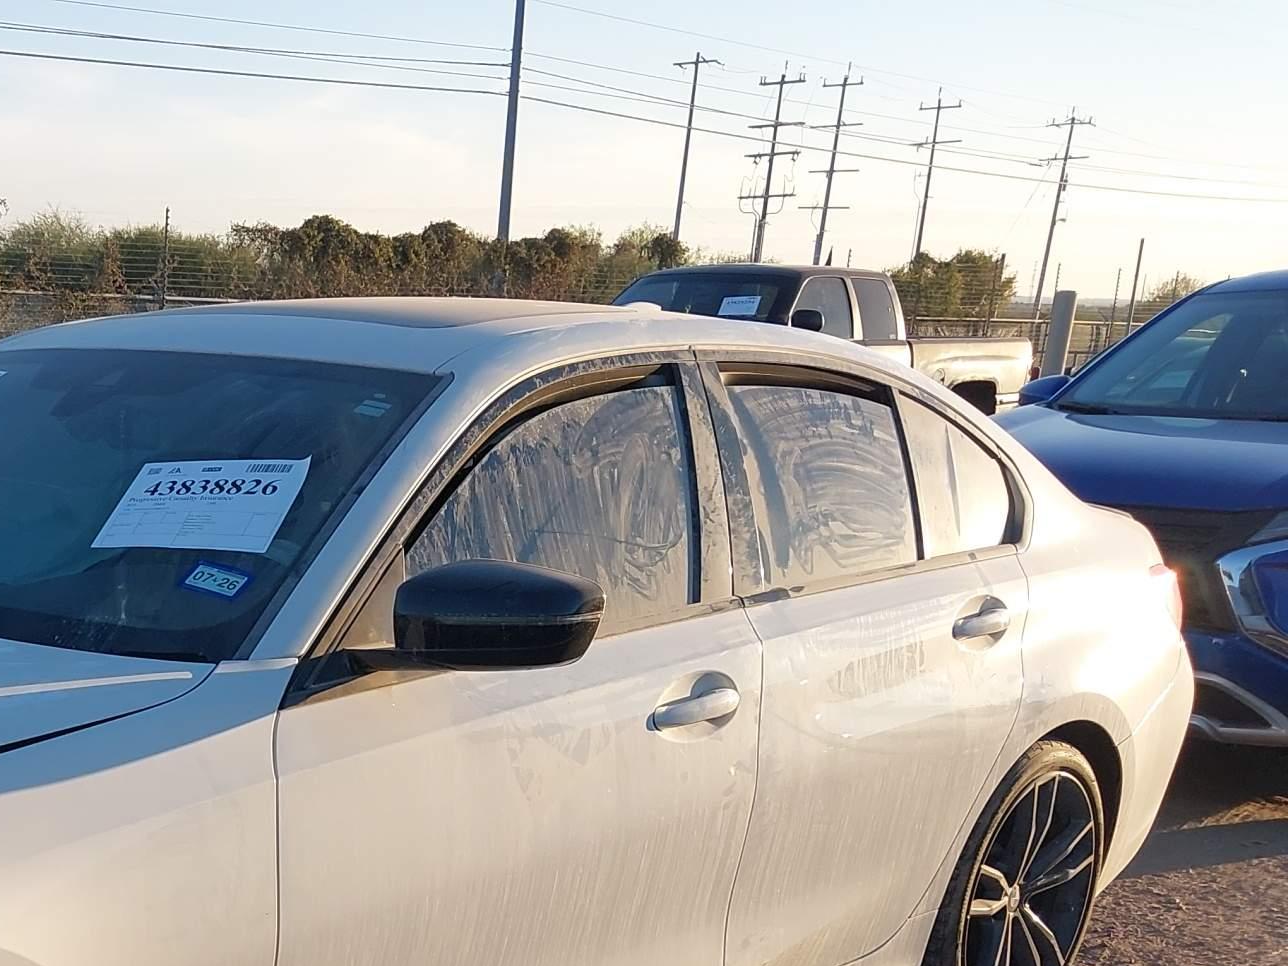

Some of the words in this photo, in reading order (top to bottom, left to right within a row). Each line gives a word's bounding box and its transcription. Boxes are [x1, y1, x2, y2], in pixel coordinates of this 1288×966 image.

[143, 478, 283, 497] 43838826
[192, 570, 216, 583] 07
[216, 577, 240, 591] 26
